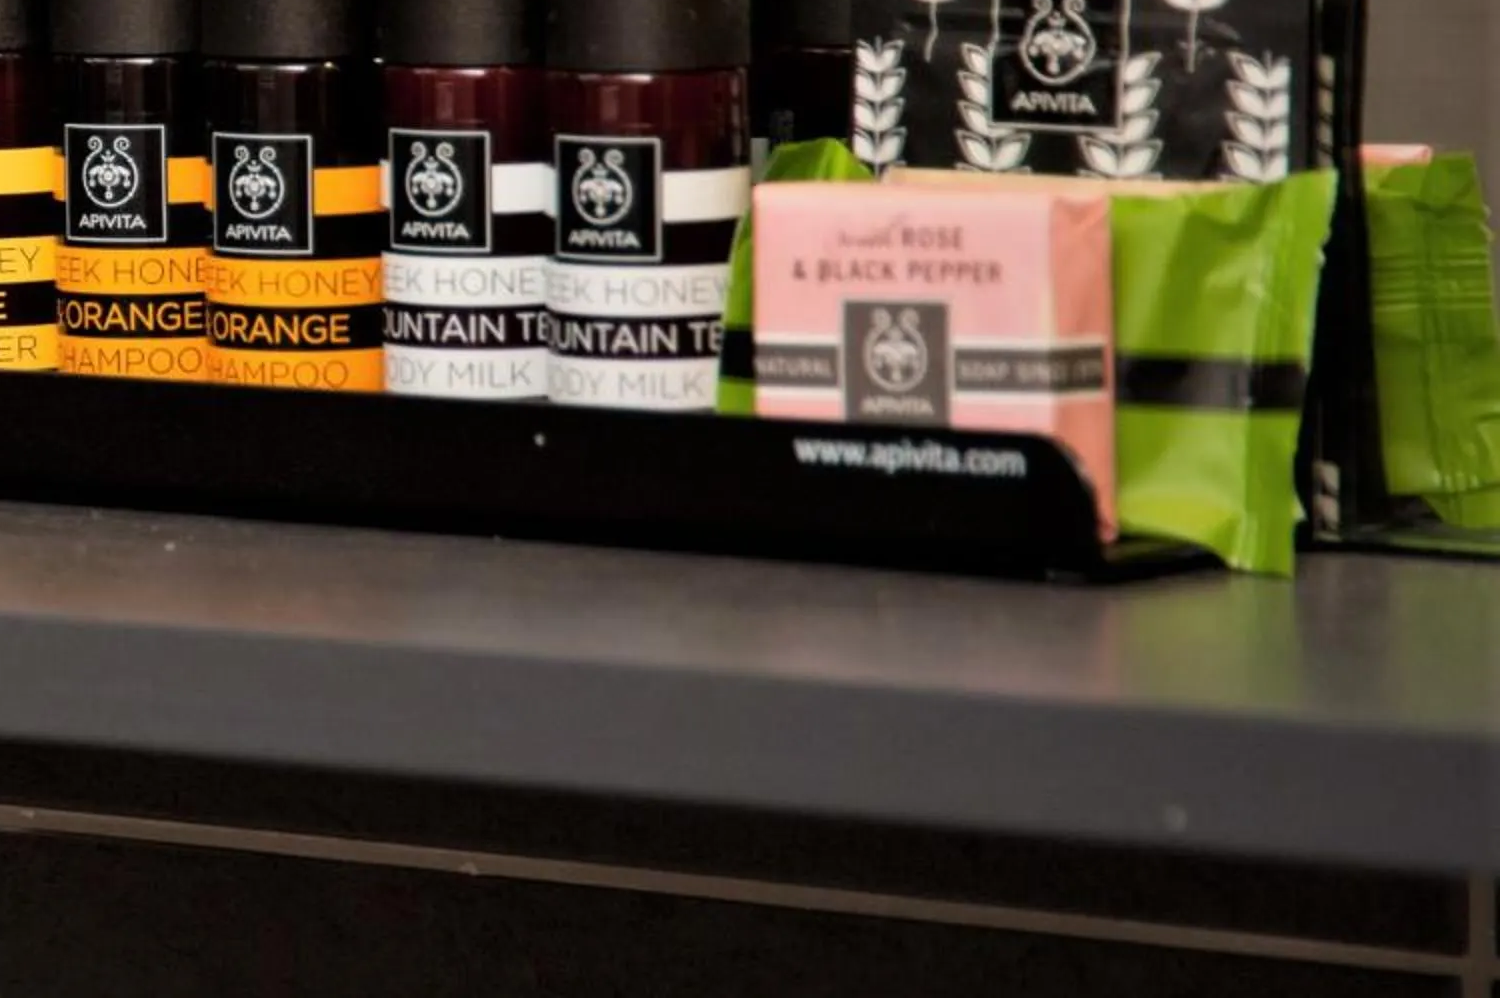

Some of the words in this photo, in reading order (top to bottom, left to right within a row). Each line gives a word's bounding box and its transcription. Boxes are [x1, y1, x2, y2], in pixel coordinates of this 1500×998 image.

[1010, 90, 1096, 114] APIVITA
[79, 213, 146, 229] APIVITA
[226, 224, 292, 242] APIVITA
[402, 221, 469, 240] APIVITA
[569, 229, 640, 249] APIVITA
[258, 267, 380, 298] HONEY
[817, 258, 898, 286] BLACK
[906, 259, 1002, 285] PEPPER
[66, 299, 204, 331] ORANGE
[213, 311, 351, 344] ORANGE
[448, 360, 532, 389] MILK
[618, 370, 706, 400] MILK
[793, 437, 1027, 478] www.apivita.com
